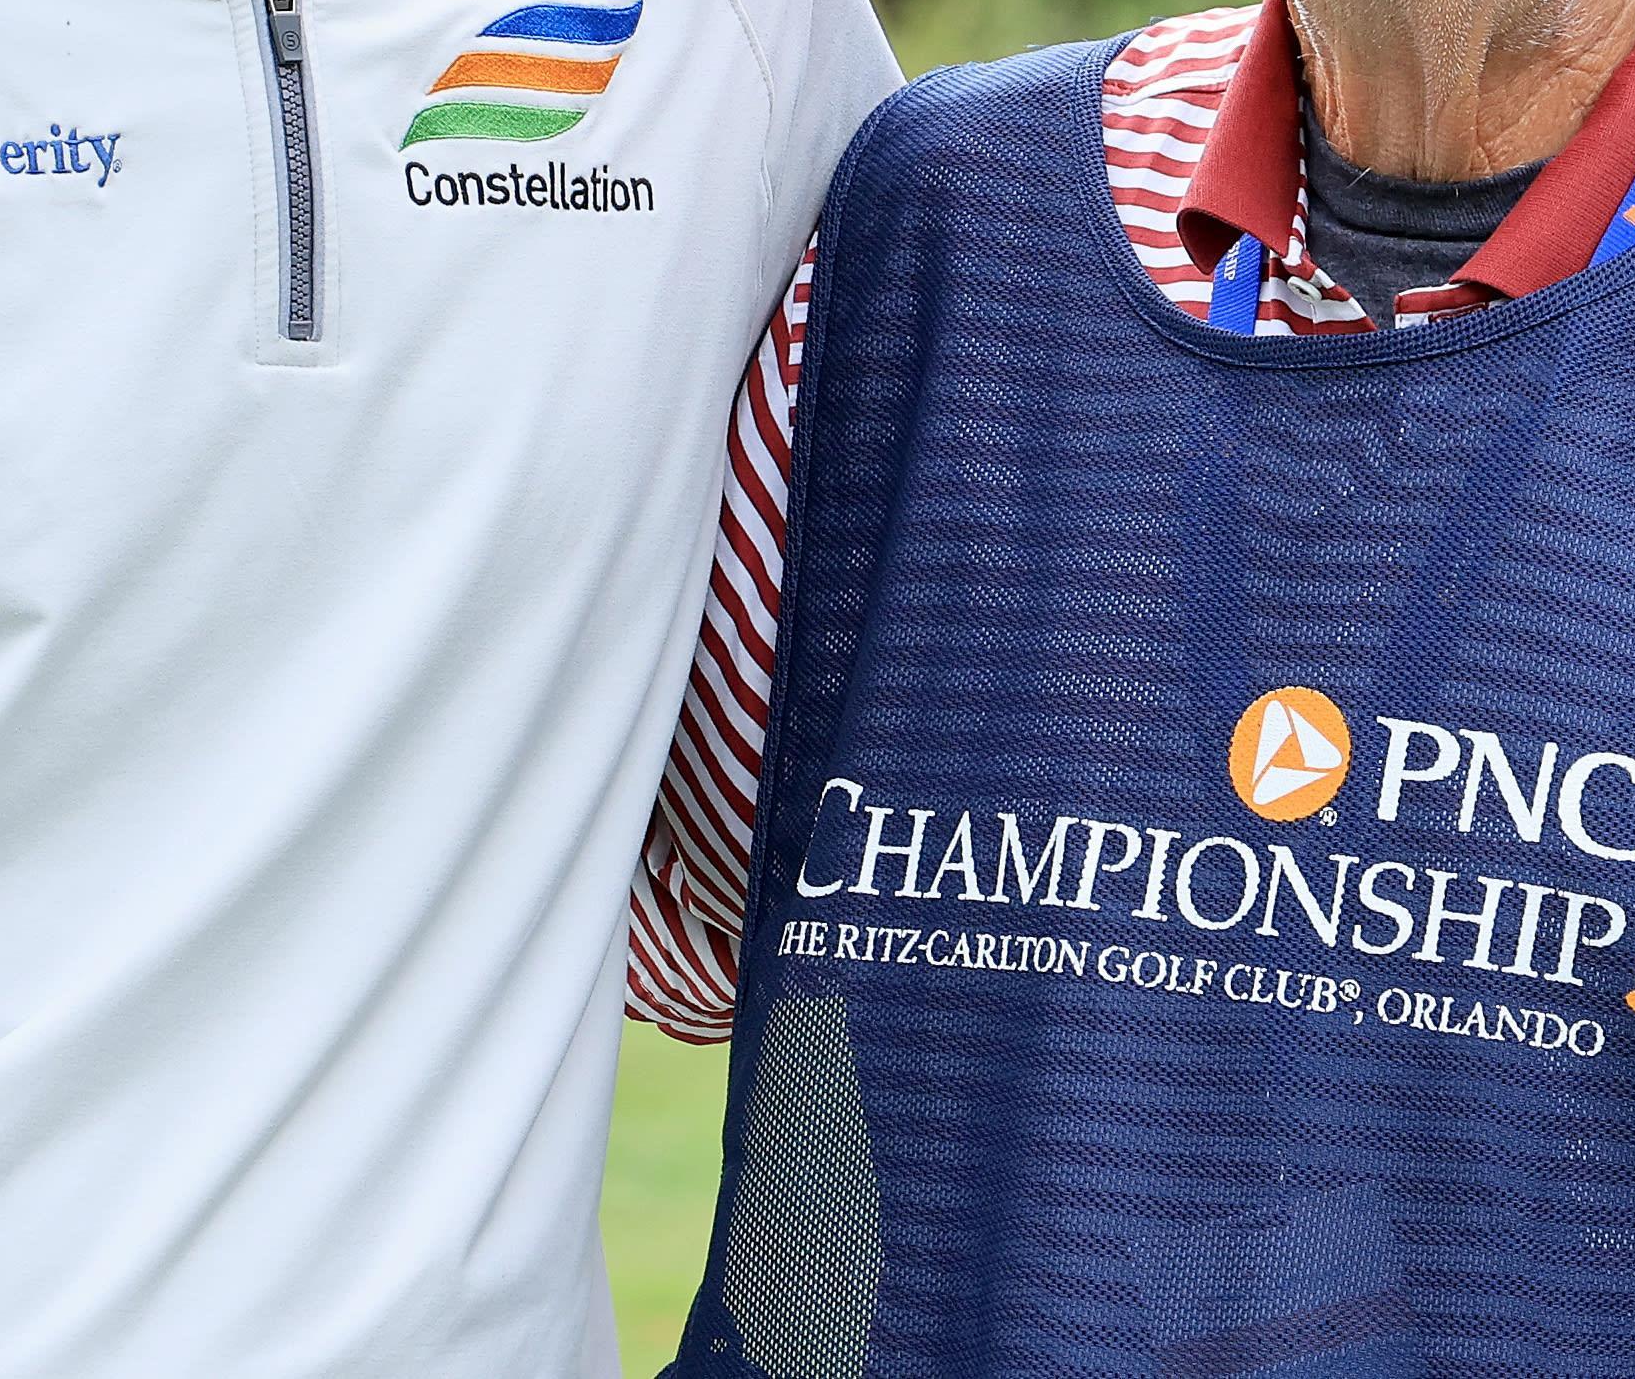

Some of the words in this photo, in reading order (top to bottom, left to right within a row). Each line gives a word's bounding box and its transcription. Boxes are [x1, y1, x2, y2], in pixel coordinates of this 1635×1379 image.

[405, 161, 654, 212] Constellation
[796, 777, 1627, 987] CHAMPIONSHIP
[777, 921, 828, 958] HE
[833, 923, 1090, 976] RITZ-CARLTON
[1097, 945, 1218, 996] GOLF
[1377, 987, 1605, 1057] ORLANDO
